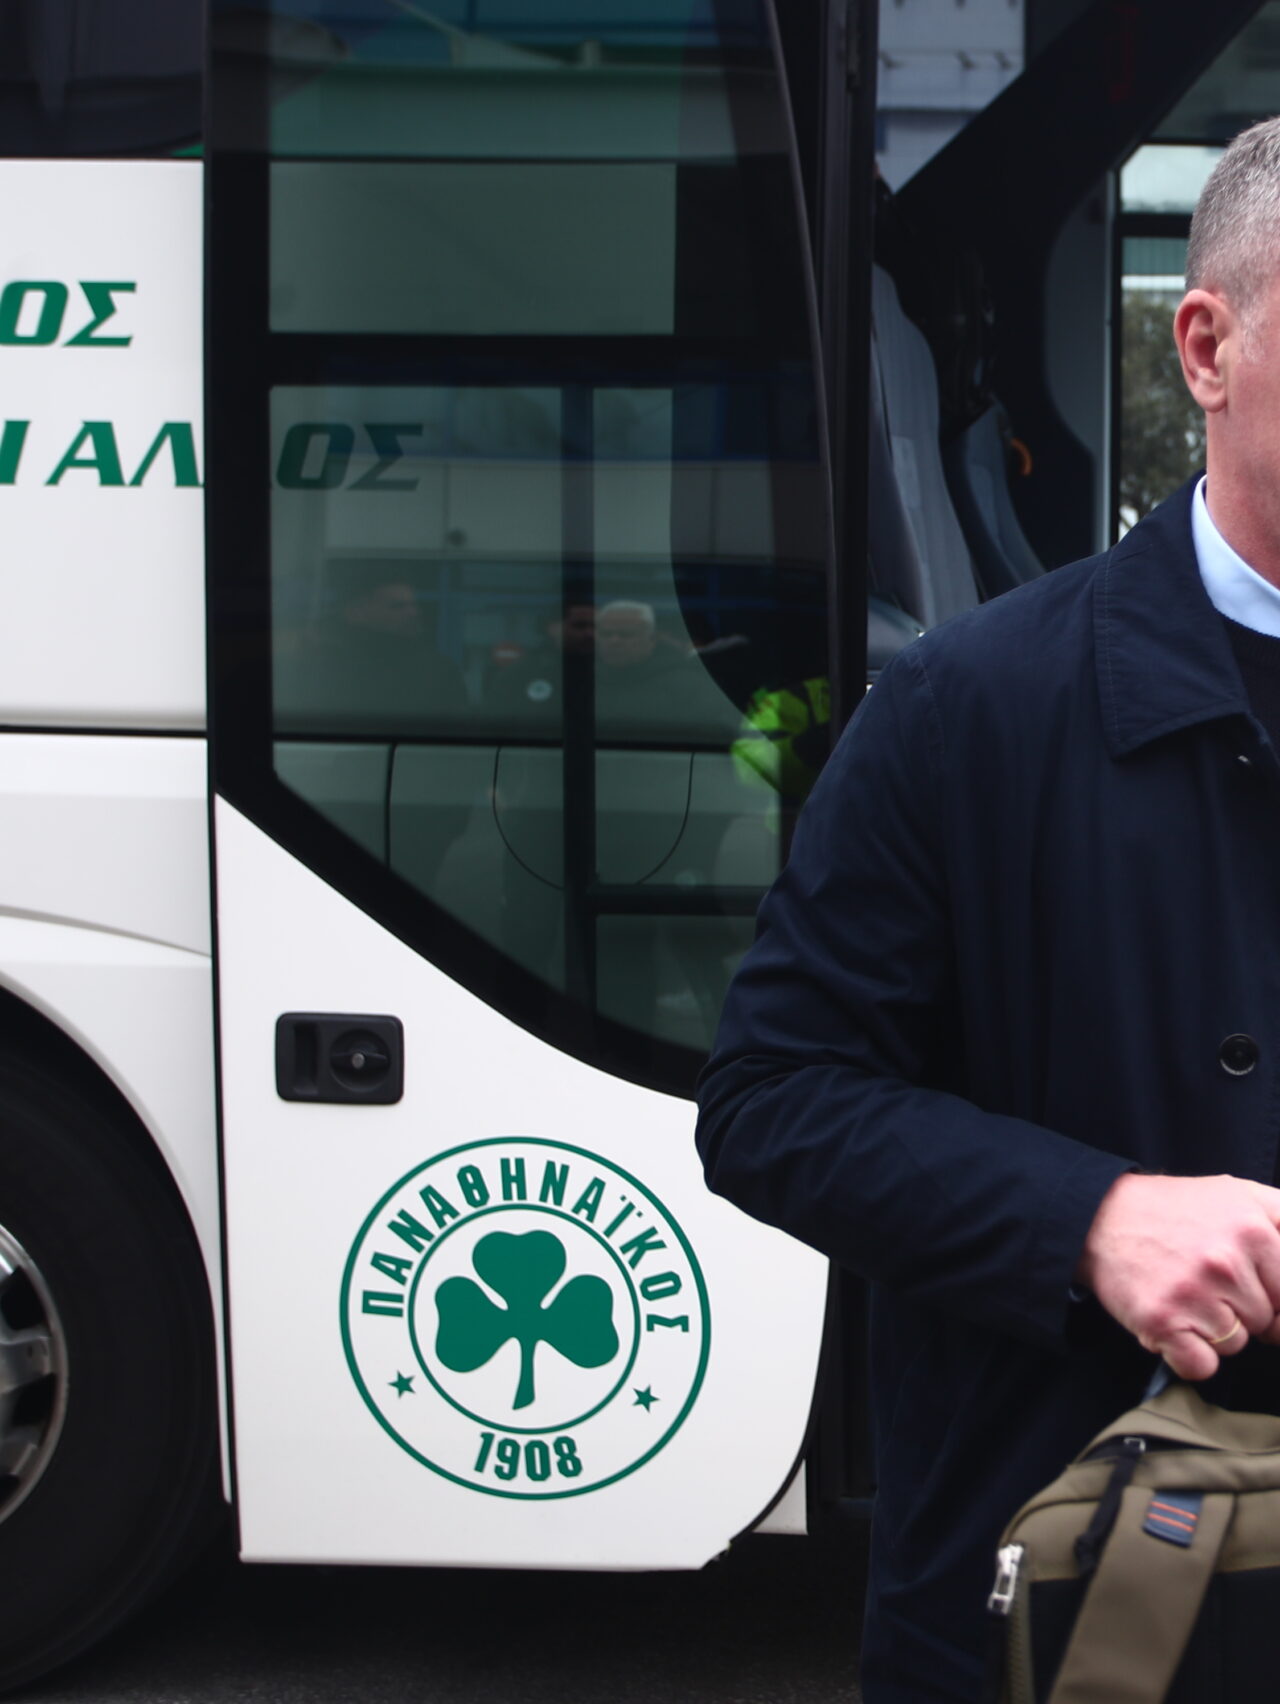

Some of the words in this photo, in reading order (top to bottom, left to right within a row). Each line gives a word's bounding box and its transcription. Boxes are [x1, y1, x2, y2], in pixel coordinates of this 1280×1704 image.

[0, 280, 137, 347] ΟΣ
[361, 1157, 690, 1333] ΠΑΝΑΘΗΝΑΪΚΟΣ
[474, 1432, 583, 1482] 1908
